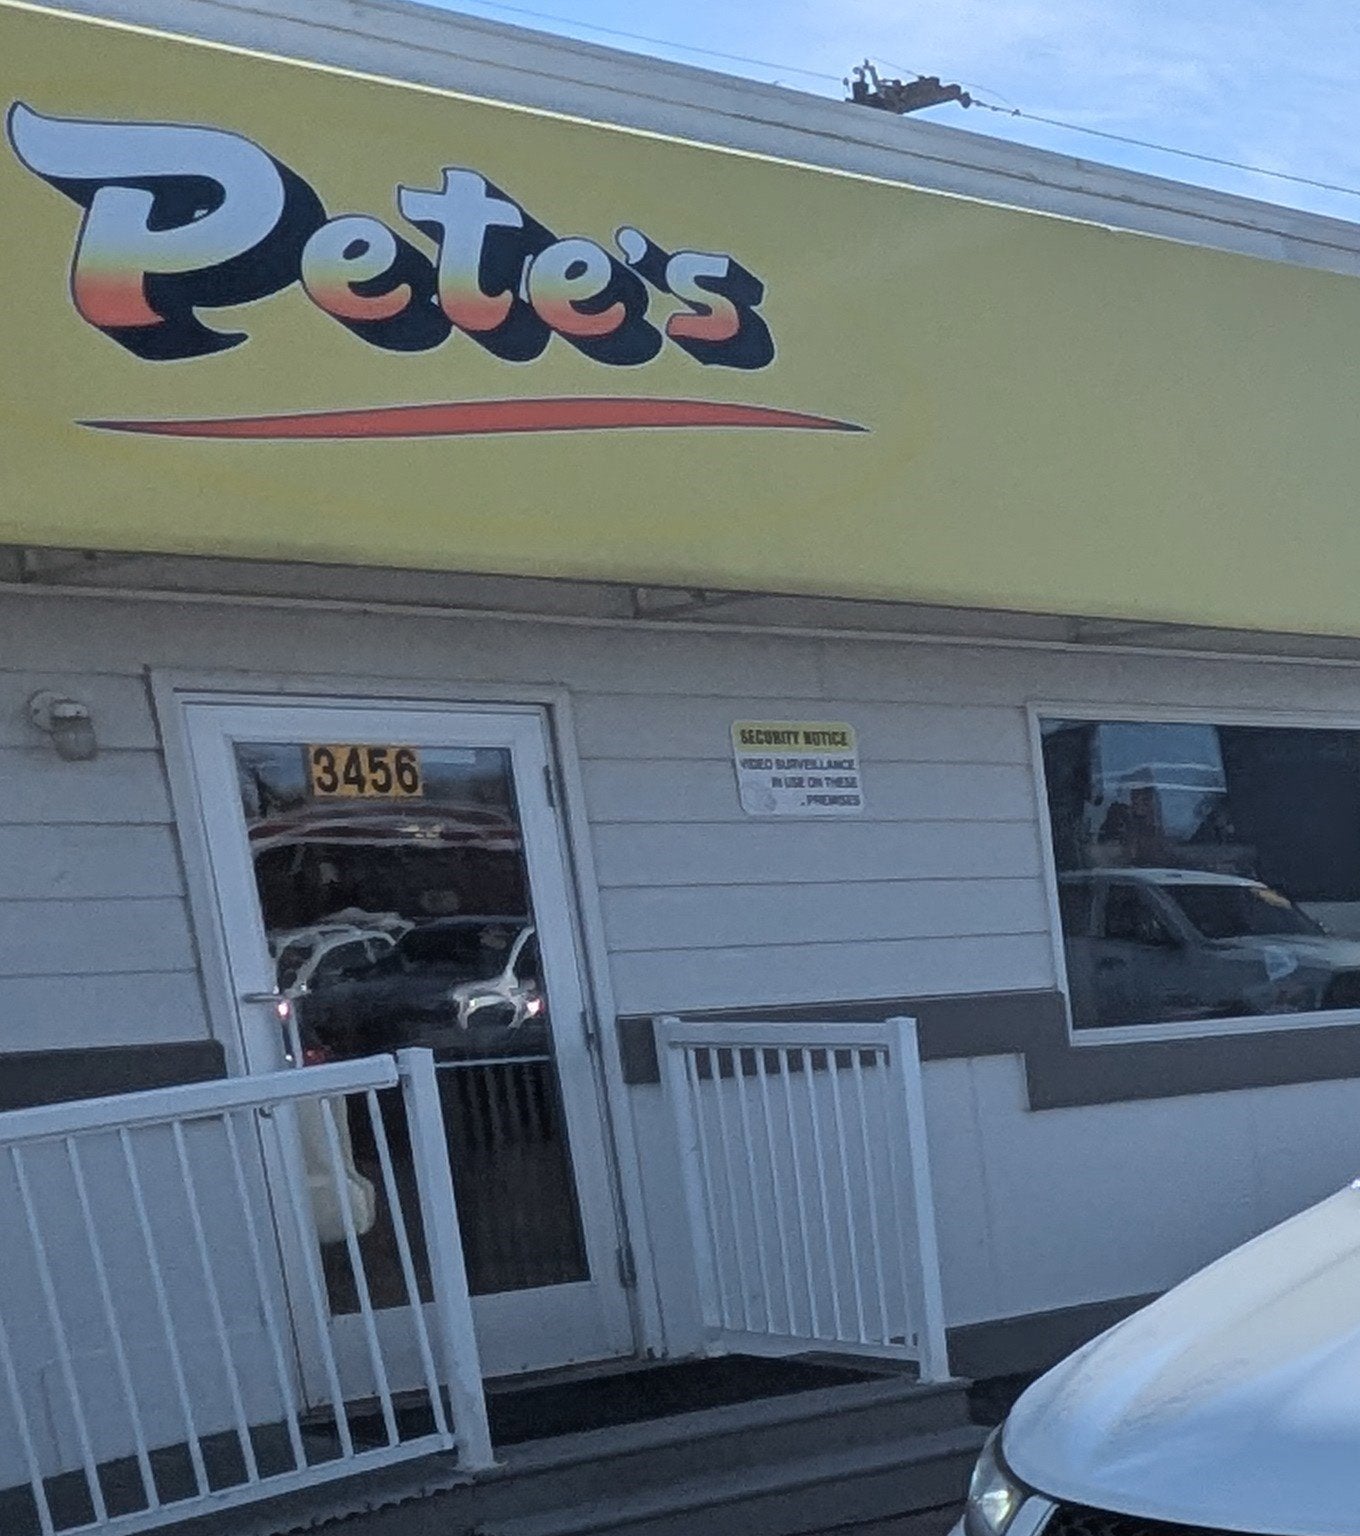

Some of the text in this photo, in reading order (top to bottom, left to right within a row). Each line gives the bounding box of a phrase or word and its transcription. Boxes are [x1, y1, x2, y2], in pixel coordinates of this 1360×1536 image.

[7, 100, 775, 369] Pete's
[740, 729, 848, 746] SECURITY NOTICE
[313, 748, 420, 794] 3456
[741, 758, 856, 770] VIDEO SURVEILLANCE
[808, 777, 823, 788] ON
[825, 777, 858, 788] THESE
